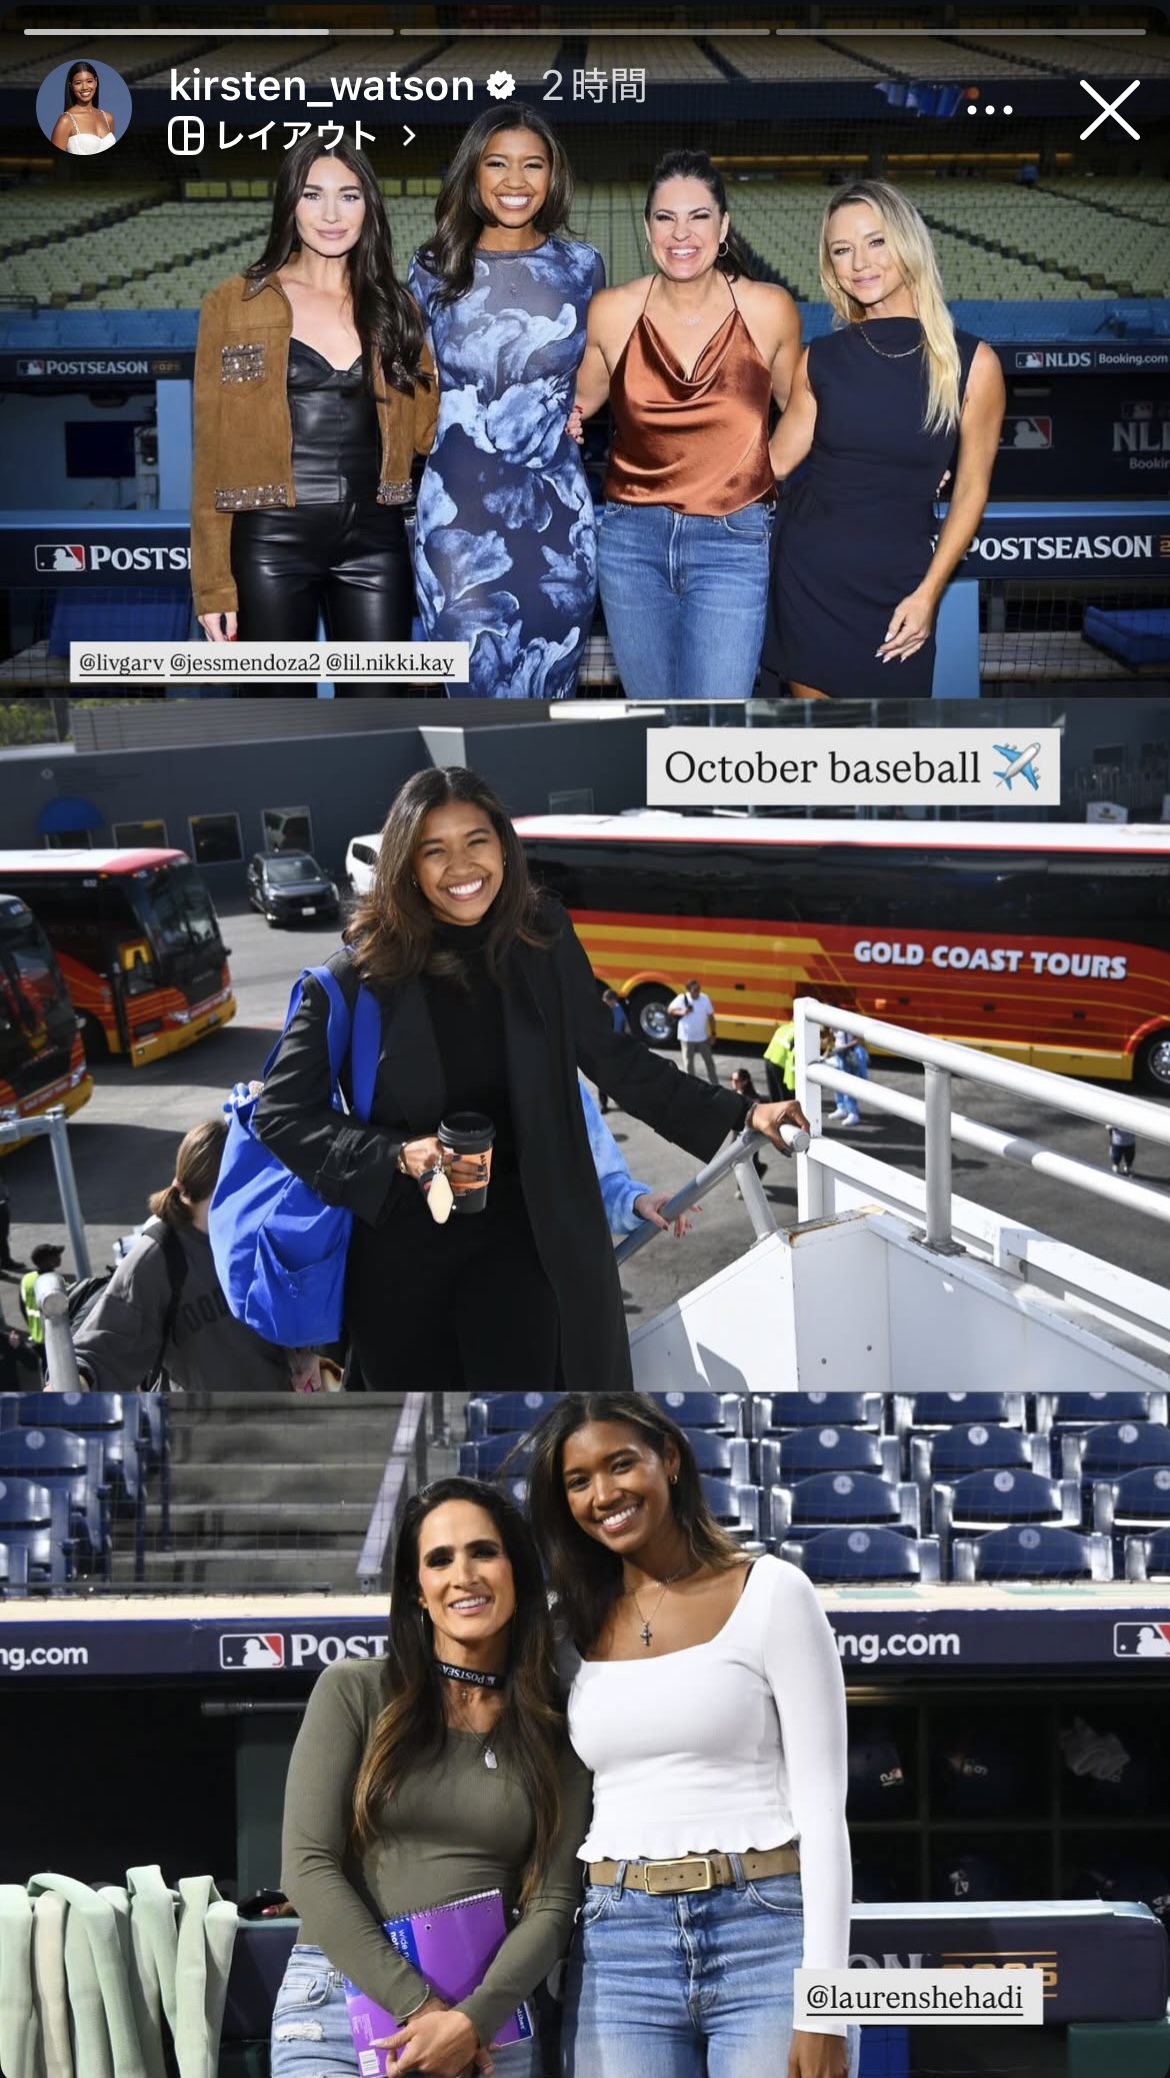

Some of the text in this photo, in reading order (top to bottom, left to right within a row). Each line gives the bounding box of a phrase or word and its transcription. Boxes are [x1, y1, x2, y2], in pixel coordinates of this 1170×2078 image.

[46, 360, 149, 375] POSTSEASON
[1045, 352, 1092, 368] NLDS
[1098, 353, 1169, 365] Booking.com
[90, 545, 192, 571] POSTS
[854, 940, 1127, 980] GOLD COAST TOURS
[831, 1627, 960, 1664] ng.com
